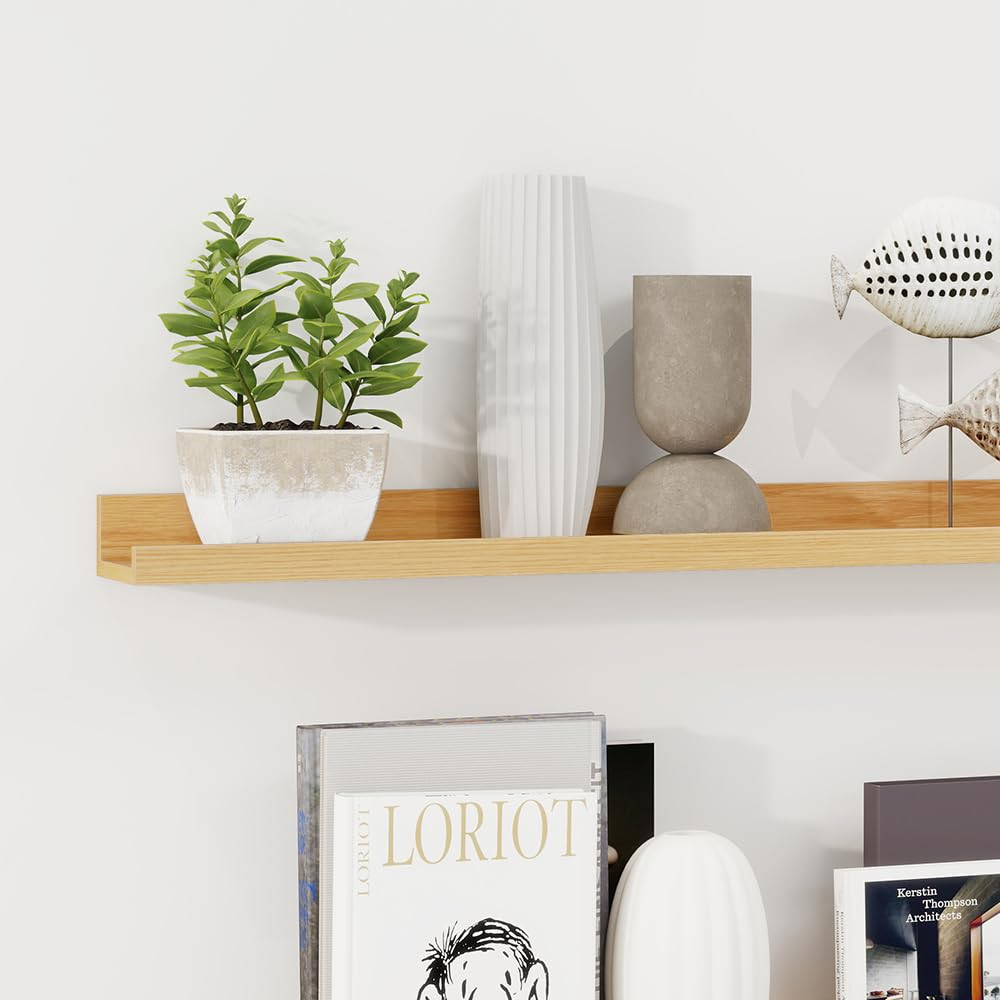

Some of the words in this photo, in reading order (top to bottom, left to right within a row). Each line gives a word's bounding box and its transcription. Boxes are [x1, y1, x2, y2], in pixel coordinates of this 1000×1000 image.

[383, 799, 587, 866] LORIOT
[357, 803, 370, 896] LORIOT
[896, 886, 938, 898] Kerstin
[922, 898, 978, 909] Thompson
[905, 912, 962, 923] Architects
